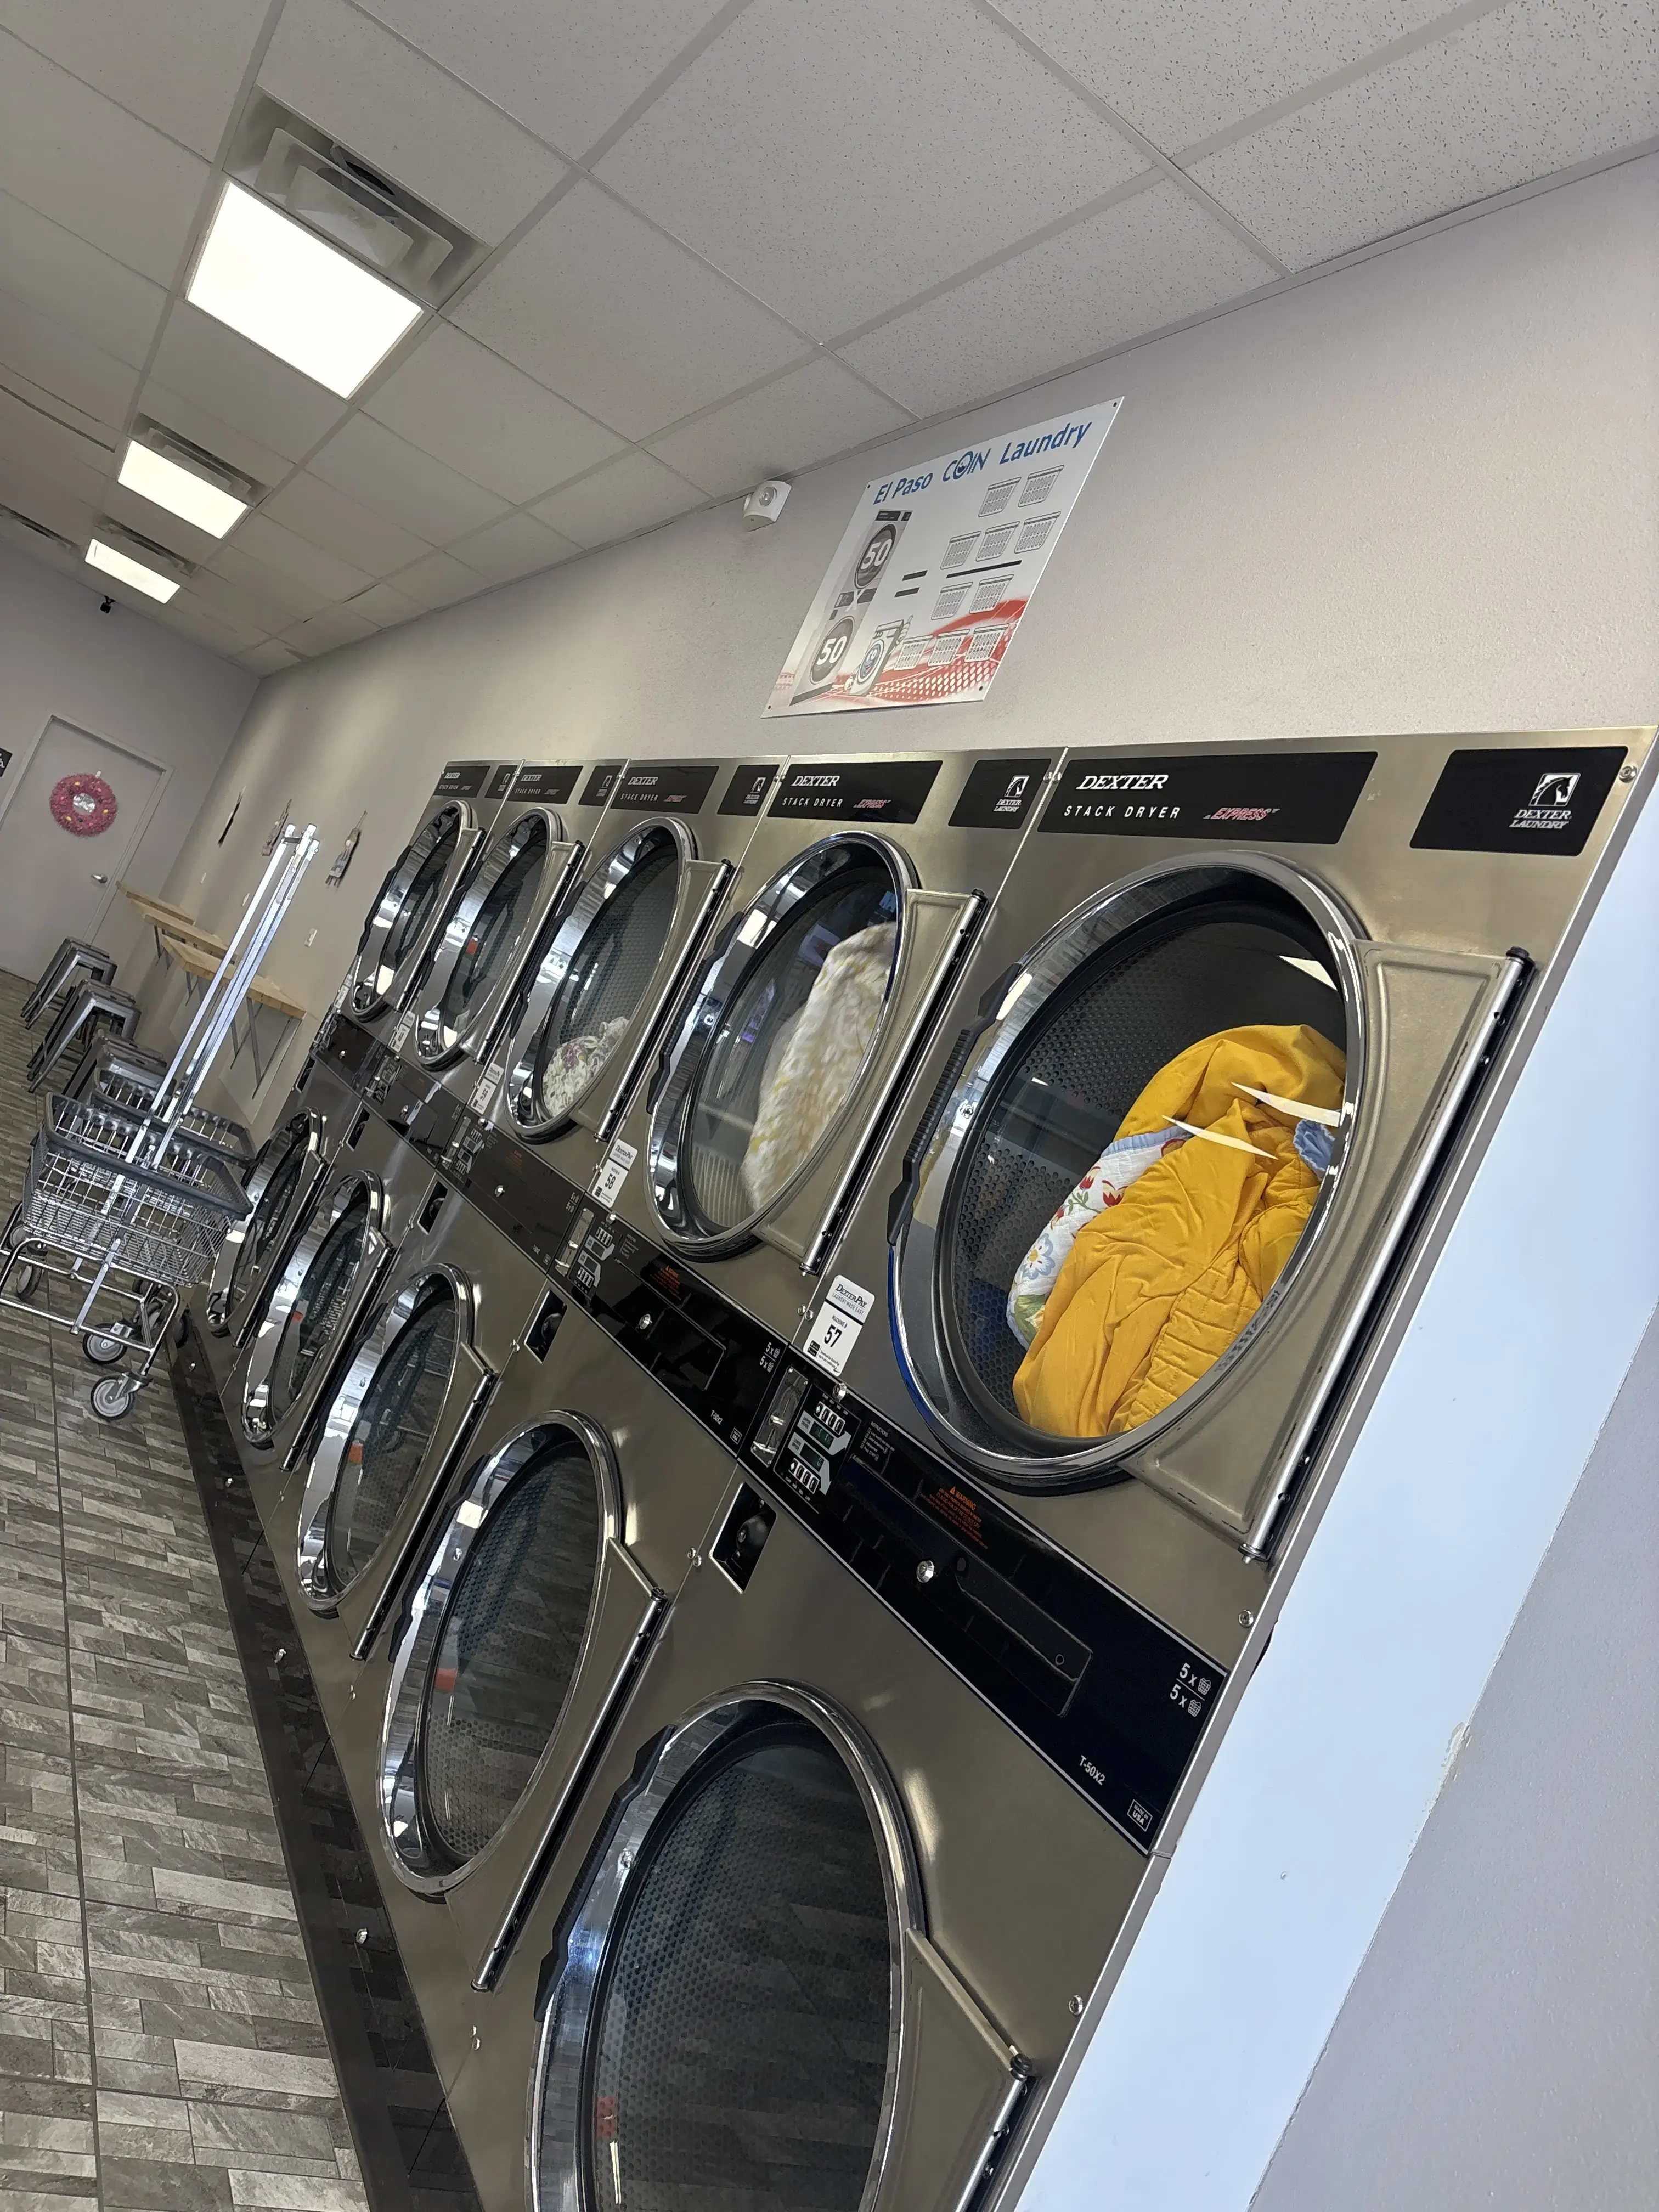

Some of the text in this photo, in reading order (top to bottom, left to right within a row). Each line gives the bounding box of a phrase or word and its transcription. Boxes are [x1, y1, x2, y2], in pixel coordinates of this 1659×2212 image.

[873, 422, 1092, 505] El Paso COIN Laundry
[861, 539, 893, 569] 50
[816, 636, 847, 665] 50
[628, 777, 658, 785] DEXTER
[791, 776, 840, 786] DEXTER
[1076, 774, 1169, 790] DEXTER
[782, 797, 843, 808] STACK DRYER
[1063, 805, 1181, 819] STACK DRYER
[1209, 808, 1273, 821] EXPRESS
[1513, 809, 1572, 819] DEXTER
[1509, 820, 1570, 830] LAUNDRY
[605, 1173, 616, 1190] 58
[832, 1292, 864, 1316] LAUNDRY MADE EASY
[824, 1324, 843, 1348] 57
[1180, 1662, 1190, 1679] 5
[1170, 1683, 1181, 1700] 5
[1079, 1755, 1105, 1786] T-50X2
[1132, 1810, 1145, 1826] USA
[1133, 1804, 1145, 1816] MADE
